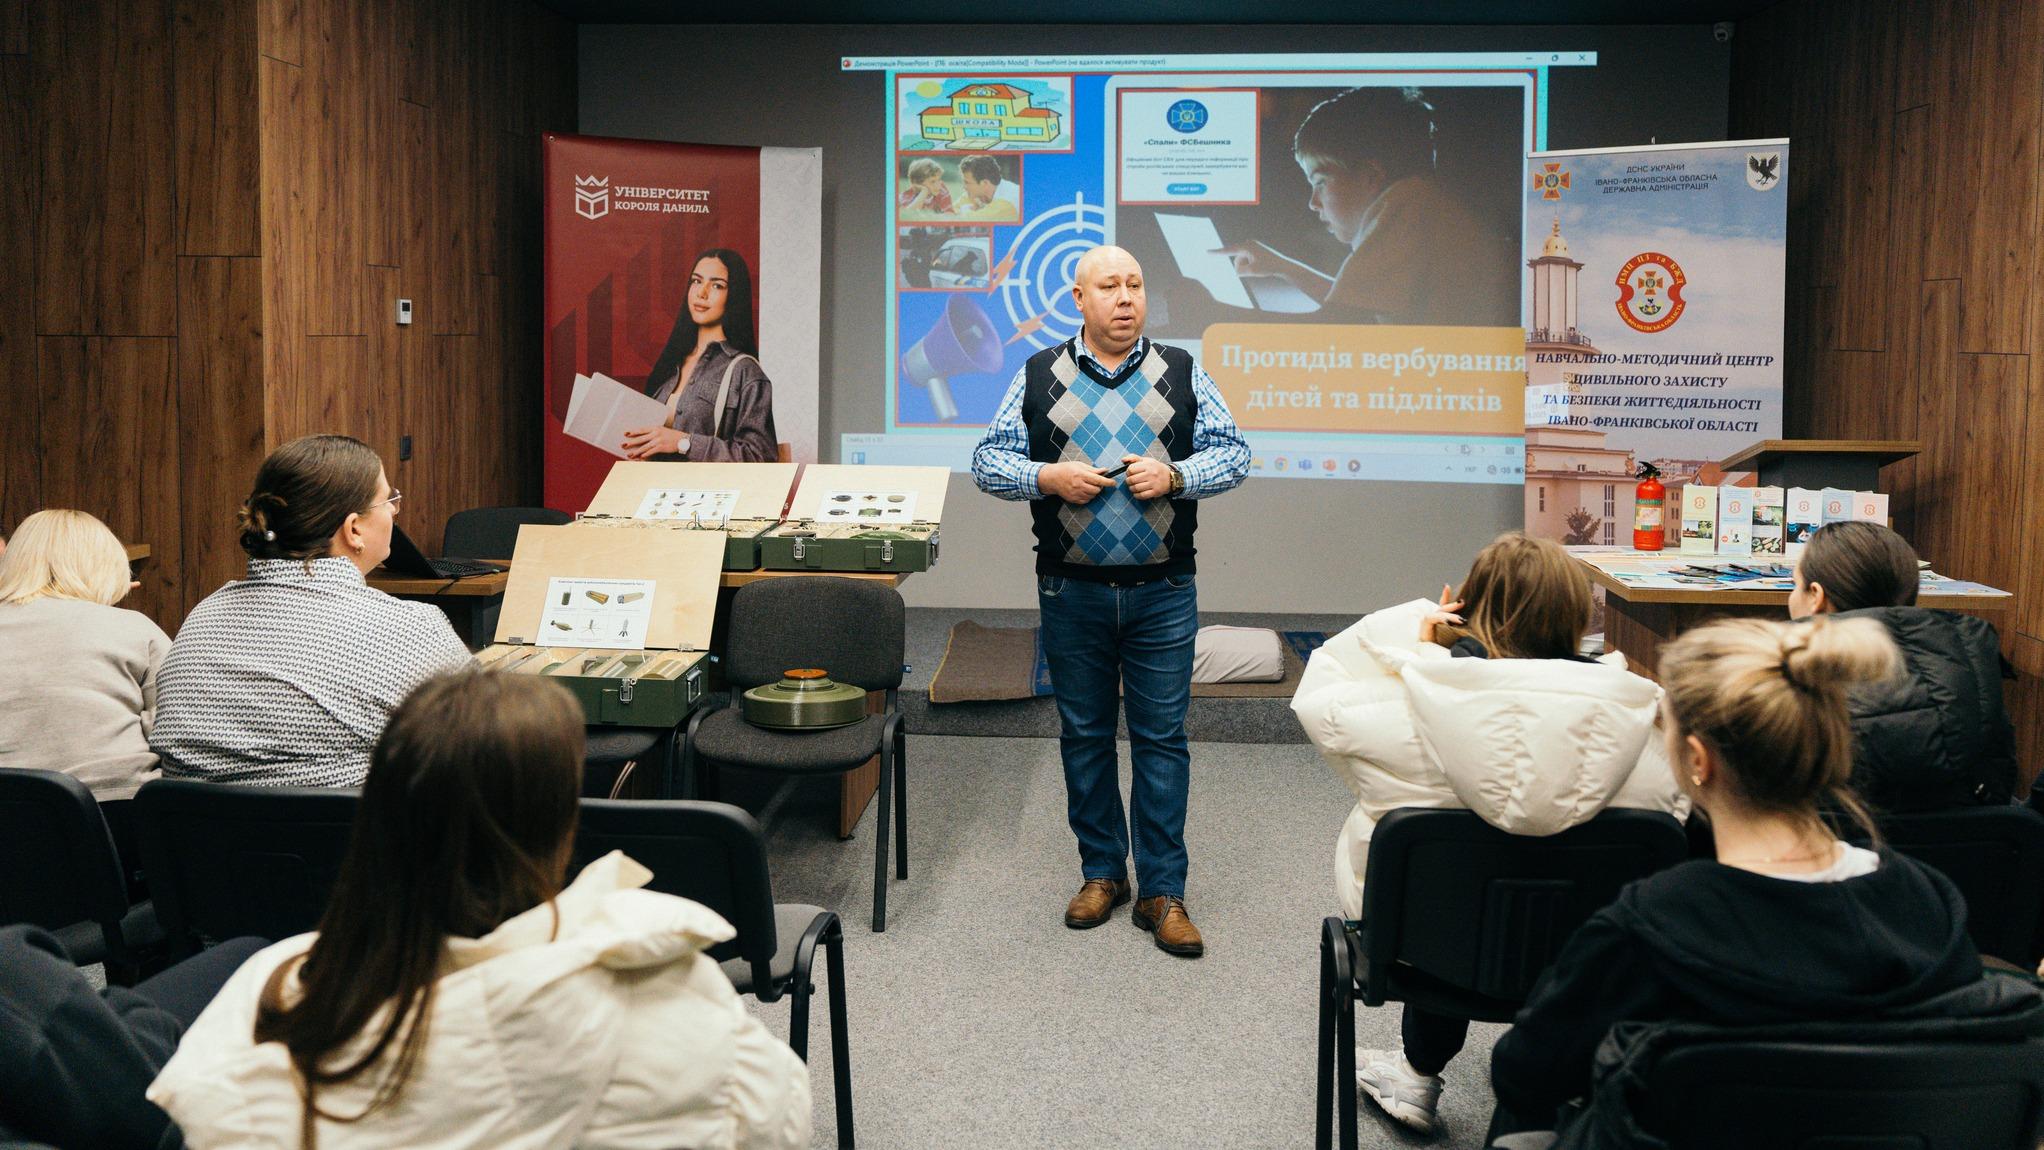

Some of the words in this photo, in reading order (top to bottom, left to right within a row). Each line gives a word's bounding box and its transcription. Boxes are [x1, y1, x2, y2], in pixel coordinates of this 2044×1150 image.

[1180, 138, 1232, 146] ФСБешника
[1626, 166, 1649, 174] ДСНС
[1650, 164, 1685, 172] УКРАЇНИ
[1595, 175, 1677, 186] ІВАНО-ФРАНКІВСЬКА
[1679, 173, 1718, 182] ОБЛАСНА
[614, 185, 710, 201] УНІВЕРСИТЕТ
[1602, 184, 1647, 194] ДЕРЖАВНА
[1649, 182, 1709, 192] АДМІНІСТРАЦІЯ
[614, 201, 660, 212] КОРОЛЯ
[662, 203, 710, 214] ДАНИЛА
[1221, 344, 1353, 374] Протидія
[1361, 347, 1526, 377] вербування
[1535, 352, 1723, 367] НАВЧАЛЬНО-МЕТОДИЧНИЙ
[1725, 355, 1774, 368] ЦЕНТР
[1573, 373, 1661, 386] ЦИВІЛЬНОГО
[1663, 376, 1728, 388] ЗАХИСТУ
[1246, 384, 1322, 411] дітей
[1330, 391, 1361, 409] та
[1368, 386, 1503, 415] підлітків
[1544, 394, 1558, 405] ТА
[1562, 394, 1621, 406] БЕЗПЕКИ
[1624, 396, 1762, 411] ЖИТТЄДІЯЛЬНОСТІ
[1548, 415, 1695, 430] ІВАНО-ФРАНКІВСЬКОЇ
[1697, 419, 1759, 433] ОБЛАСТІ
